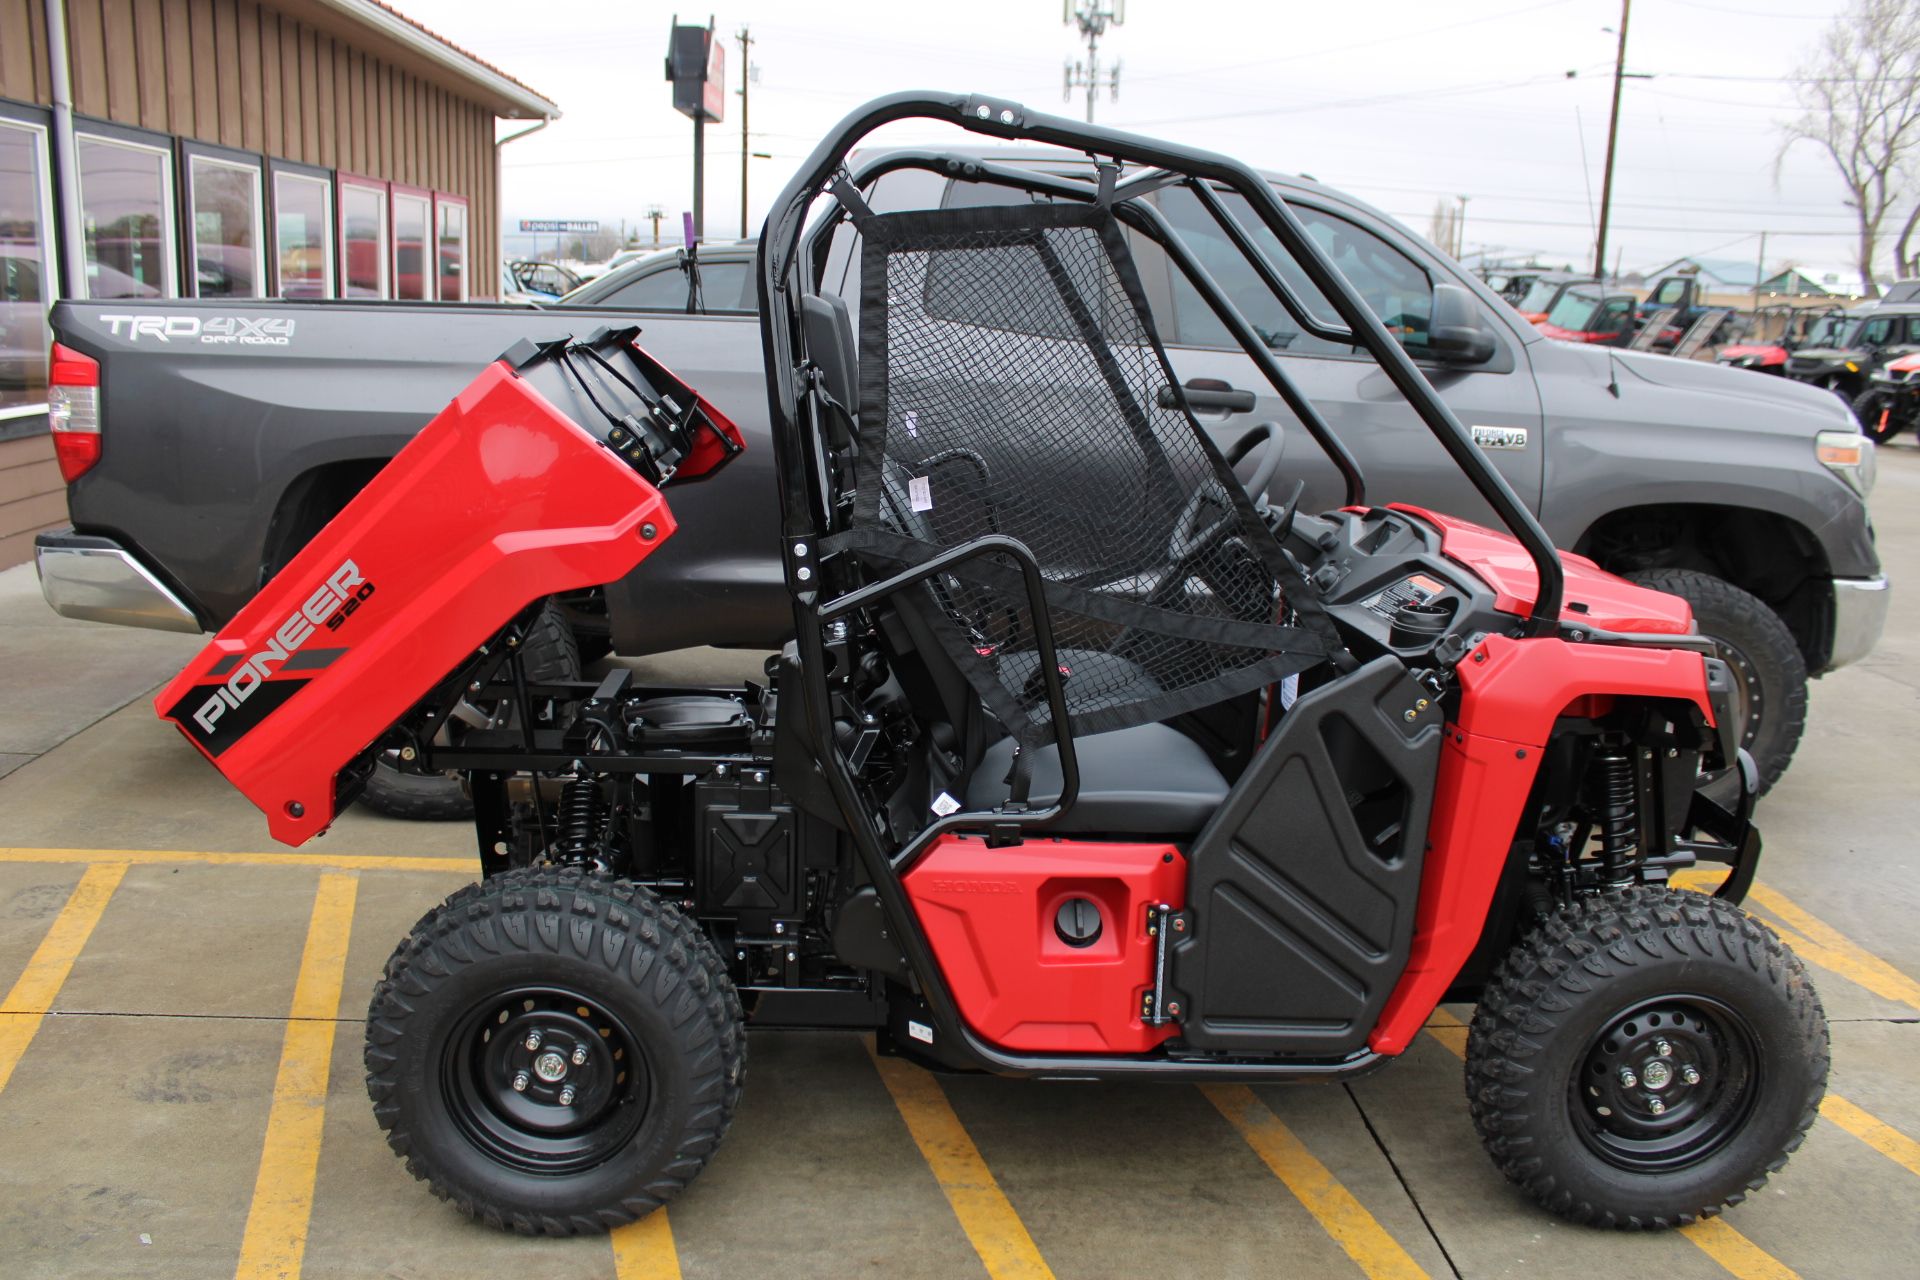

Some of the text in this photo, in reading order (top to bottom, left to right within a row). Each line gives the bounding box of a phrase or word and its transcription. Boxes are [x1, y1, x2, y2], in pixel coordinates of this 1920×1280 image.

[100, 314, 295, 342] TRD 4X4
[201, 335, 289, 345] OFF ROAD
[1506, 432, 1525, 446] V8
[326, 582, 375, 632] 520
[193, 558, 366, 735] PIONEER
[932, 880, 1023, 895] HONDA
